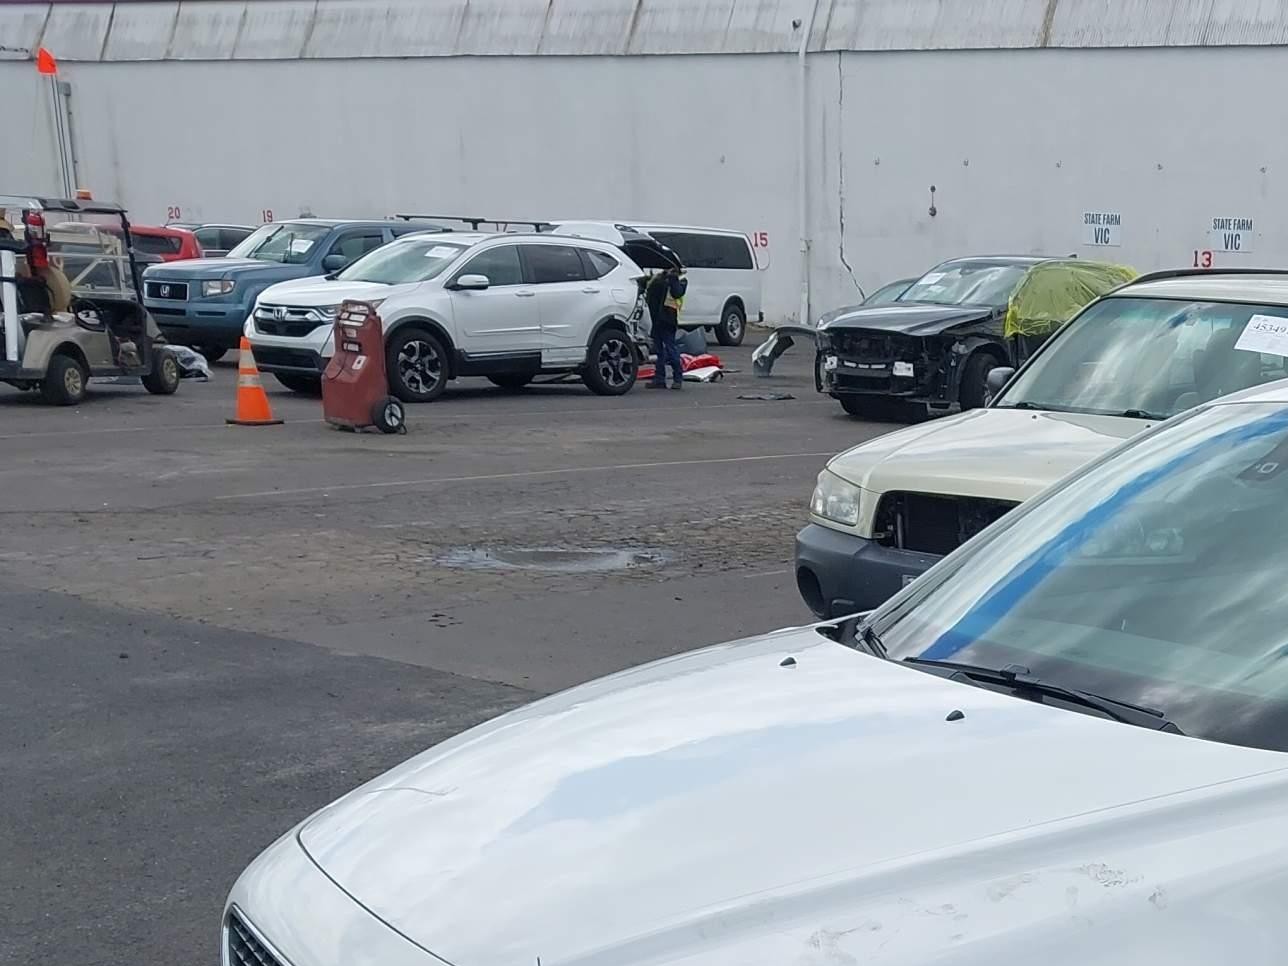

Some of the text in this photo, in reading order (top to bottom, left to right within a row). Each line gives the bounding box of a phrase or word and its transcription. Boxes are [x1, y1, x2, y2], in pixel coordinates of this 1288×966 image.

[168, 206, 181, 219] 20
[262, 209, 273, 223] 19
[1084, 213, 1121, 226] STATE FARM
[1213, 218, 1253, 231] STATE FARM
[753, 232, 768, 247] 15
[1094, 227, 1110, 245] VIC
[1223, 233, 1241, 251] VIC
[1193, 250, 1212, 268] 13
